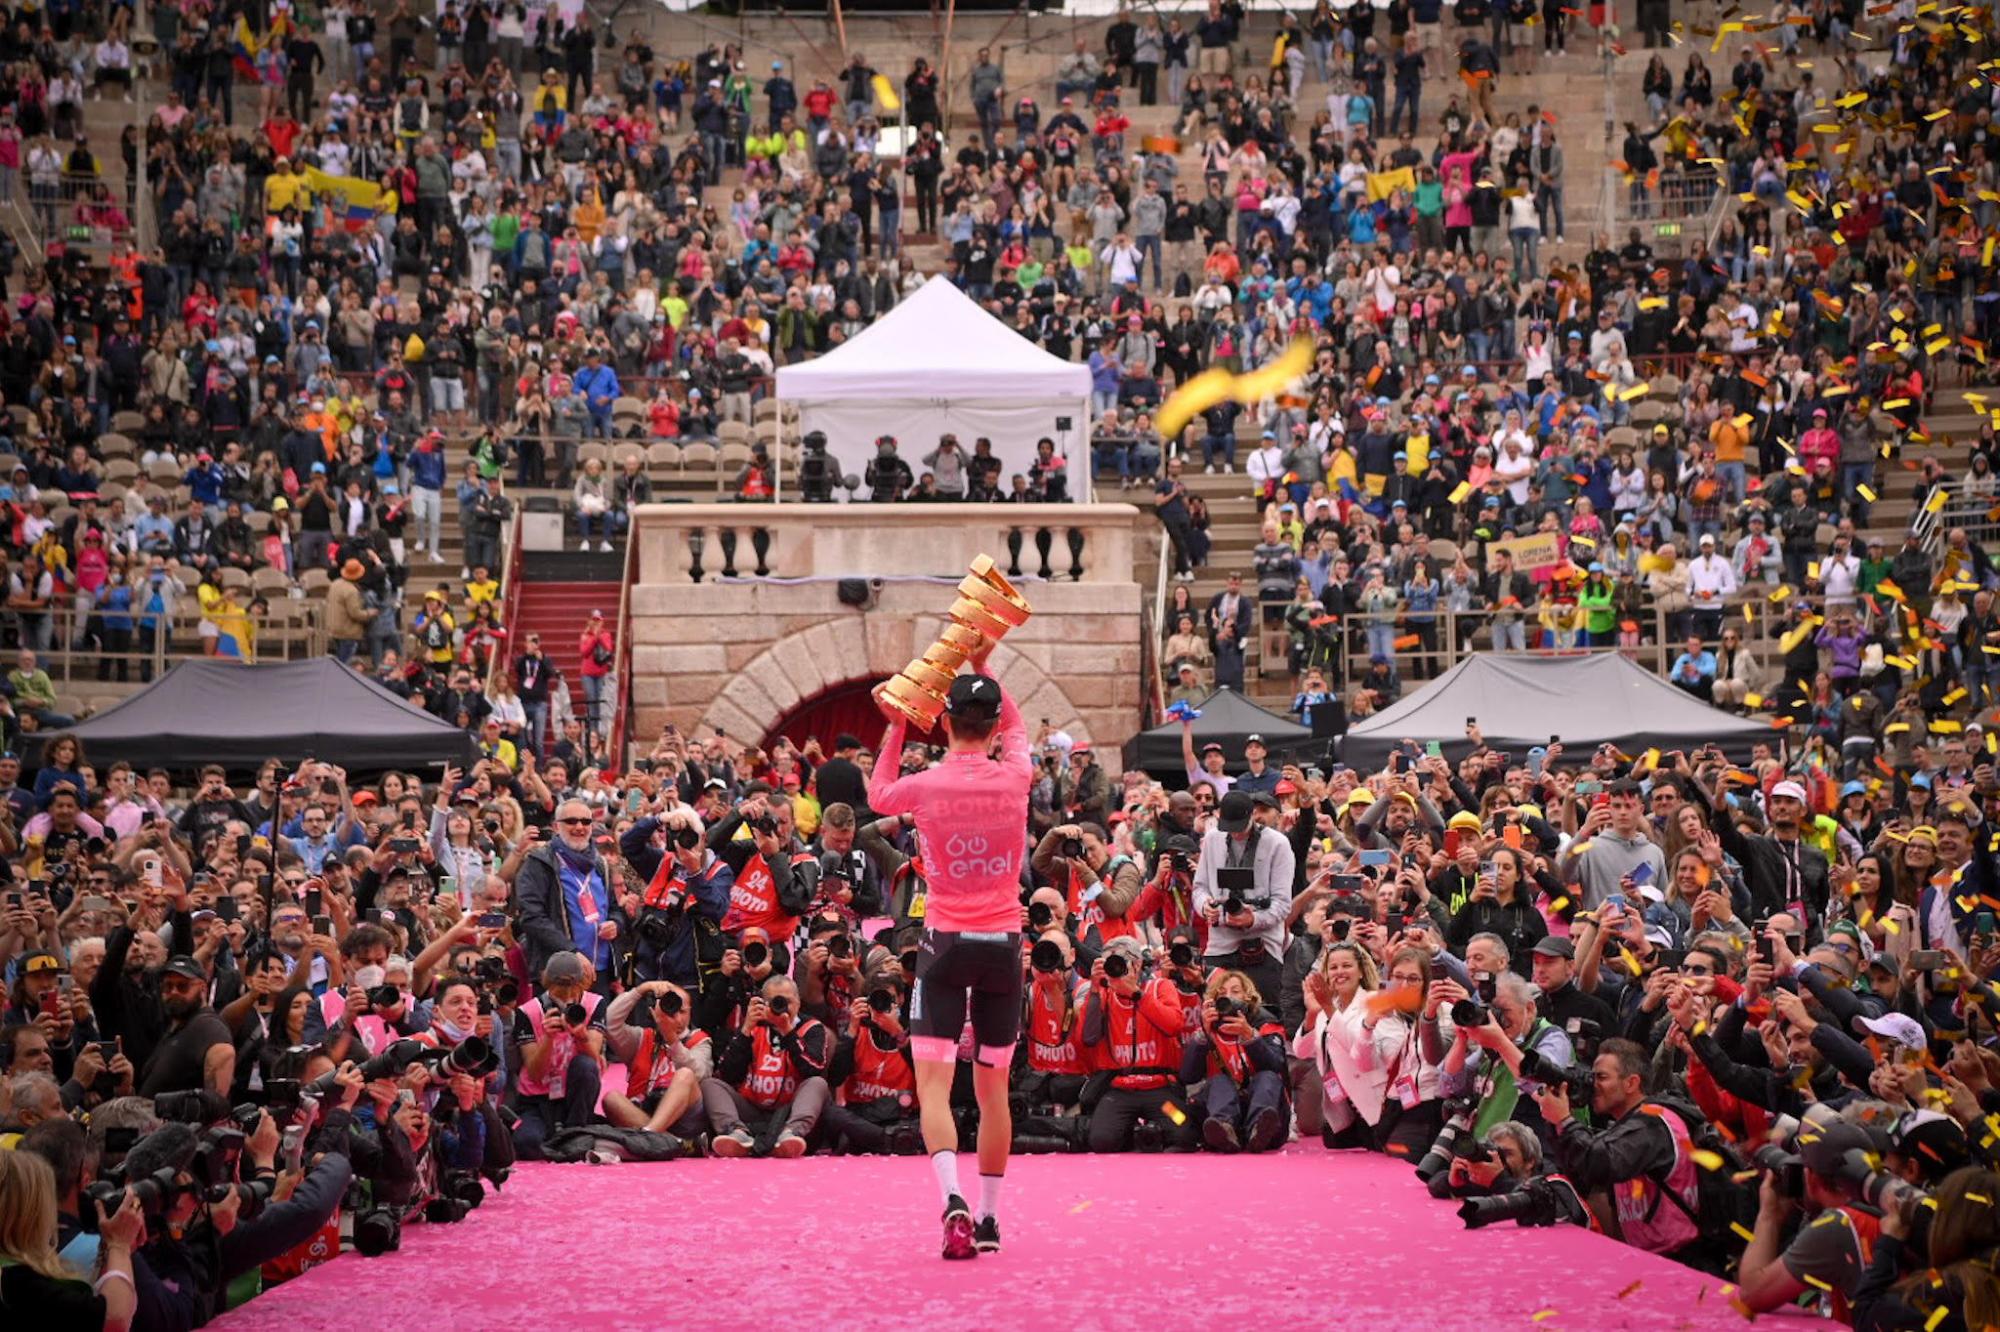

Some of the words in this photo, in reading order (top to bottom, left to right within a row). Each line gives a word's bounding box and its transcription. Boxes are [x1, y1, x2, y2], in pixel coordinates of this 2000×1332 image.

[949, 850, 1012, 879] enel
[744, 869, 769, 893] 24
[729, 885, 769, 912] PHOTO
[1035, 1040, 1077, 1062] PHOTO
[1115, 1040, 1158, 1064] PHOTO
[745, 1072, 796, 1095] PHOTO
